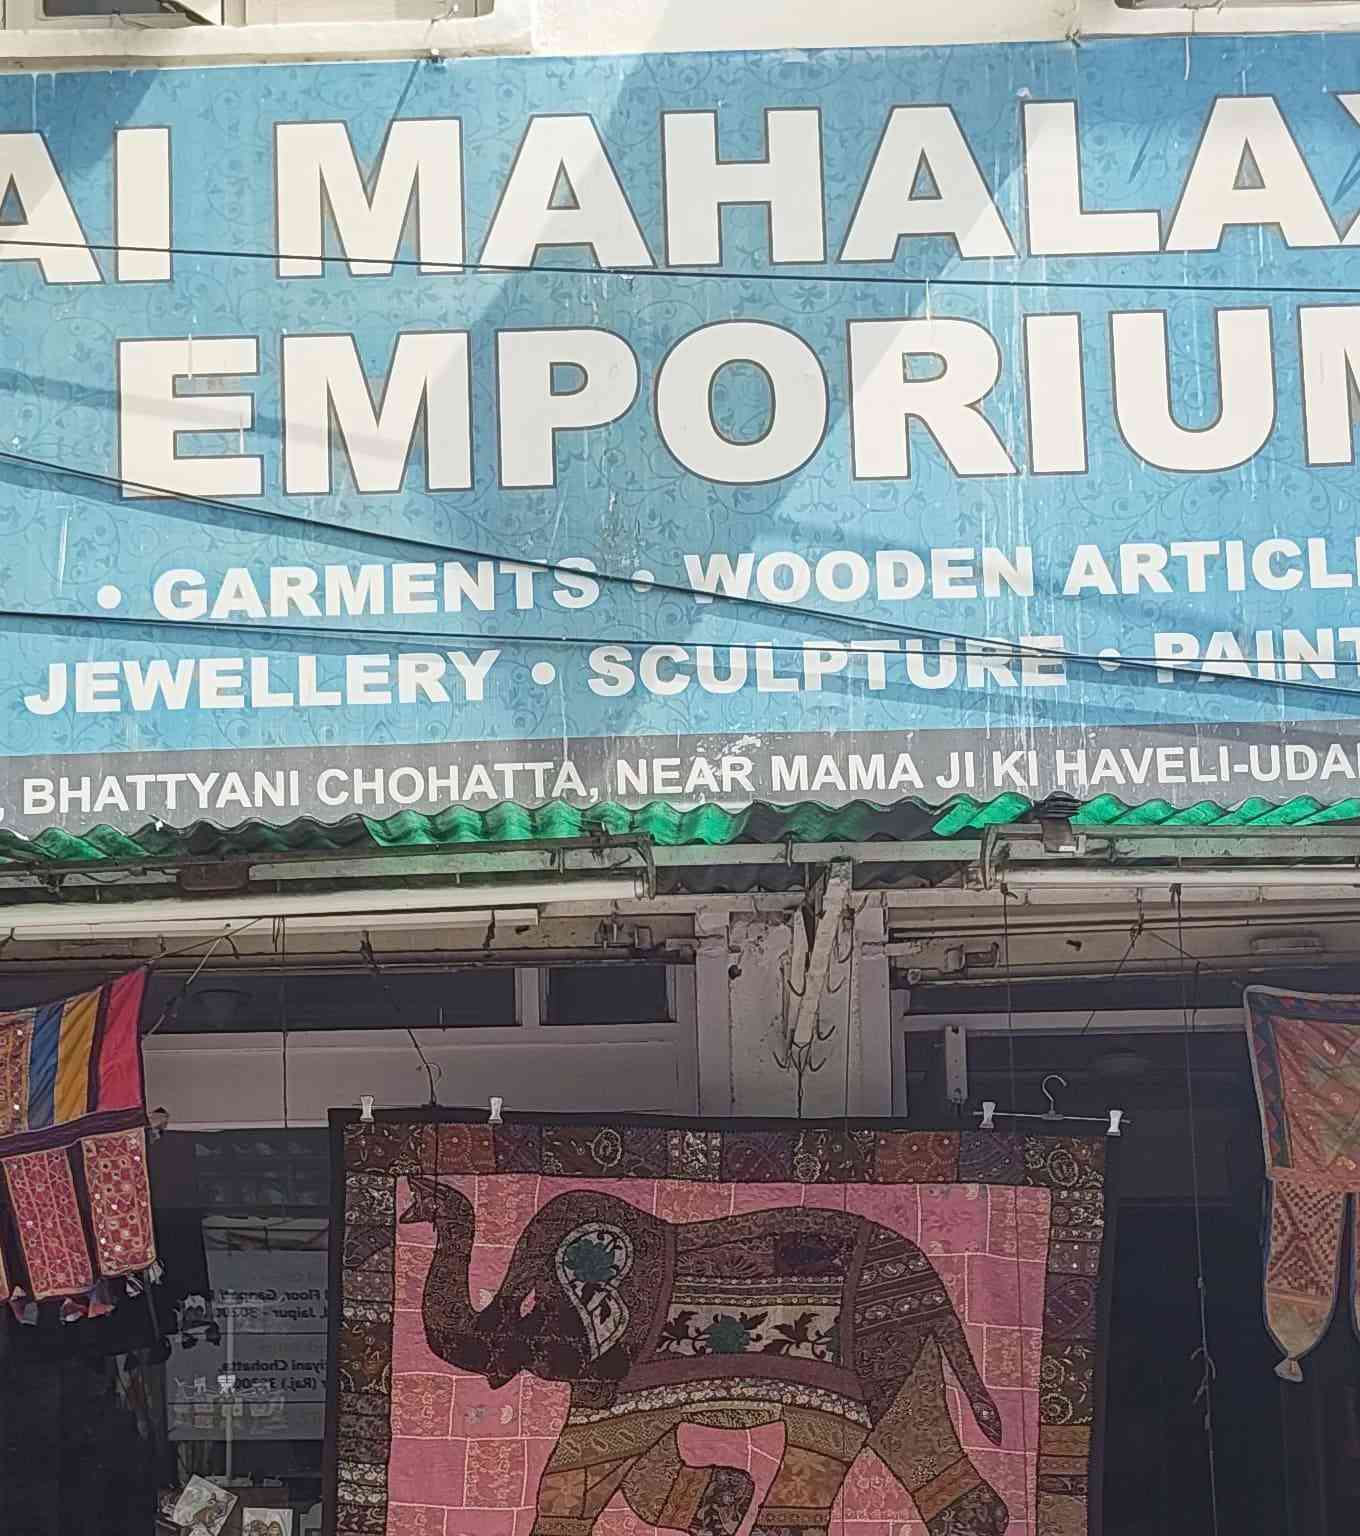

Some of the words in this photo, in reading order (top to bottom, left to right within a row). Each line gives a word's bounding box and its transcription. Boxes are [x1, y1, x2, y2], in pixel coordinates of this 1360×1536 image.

[153, 557, 600, 621] GARMENTS
[684, 546, 1035, 604] WOODEN
[23, 649, 501, 715] JEWELLERY
[587, 635, 1068, 698] SCULPTURE
[22, 769, 300, 816] BHATTYANI
[315, 759, 600, 807] CHOHATTA,
[616, 754, 756, 796] NEAR
[771, 751, 923, 793] MAMA
[935, 750, 975, 790] JI
[993, 750, 1038, 788] KI
